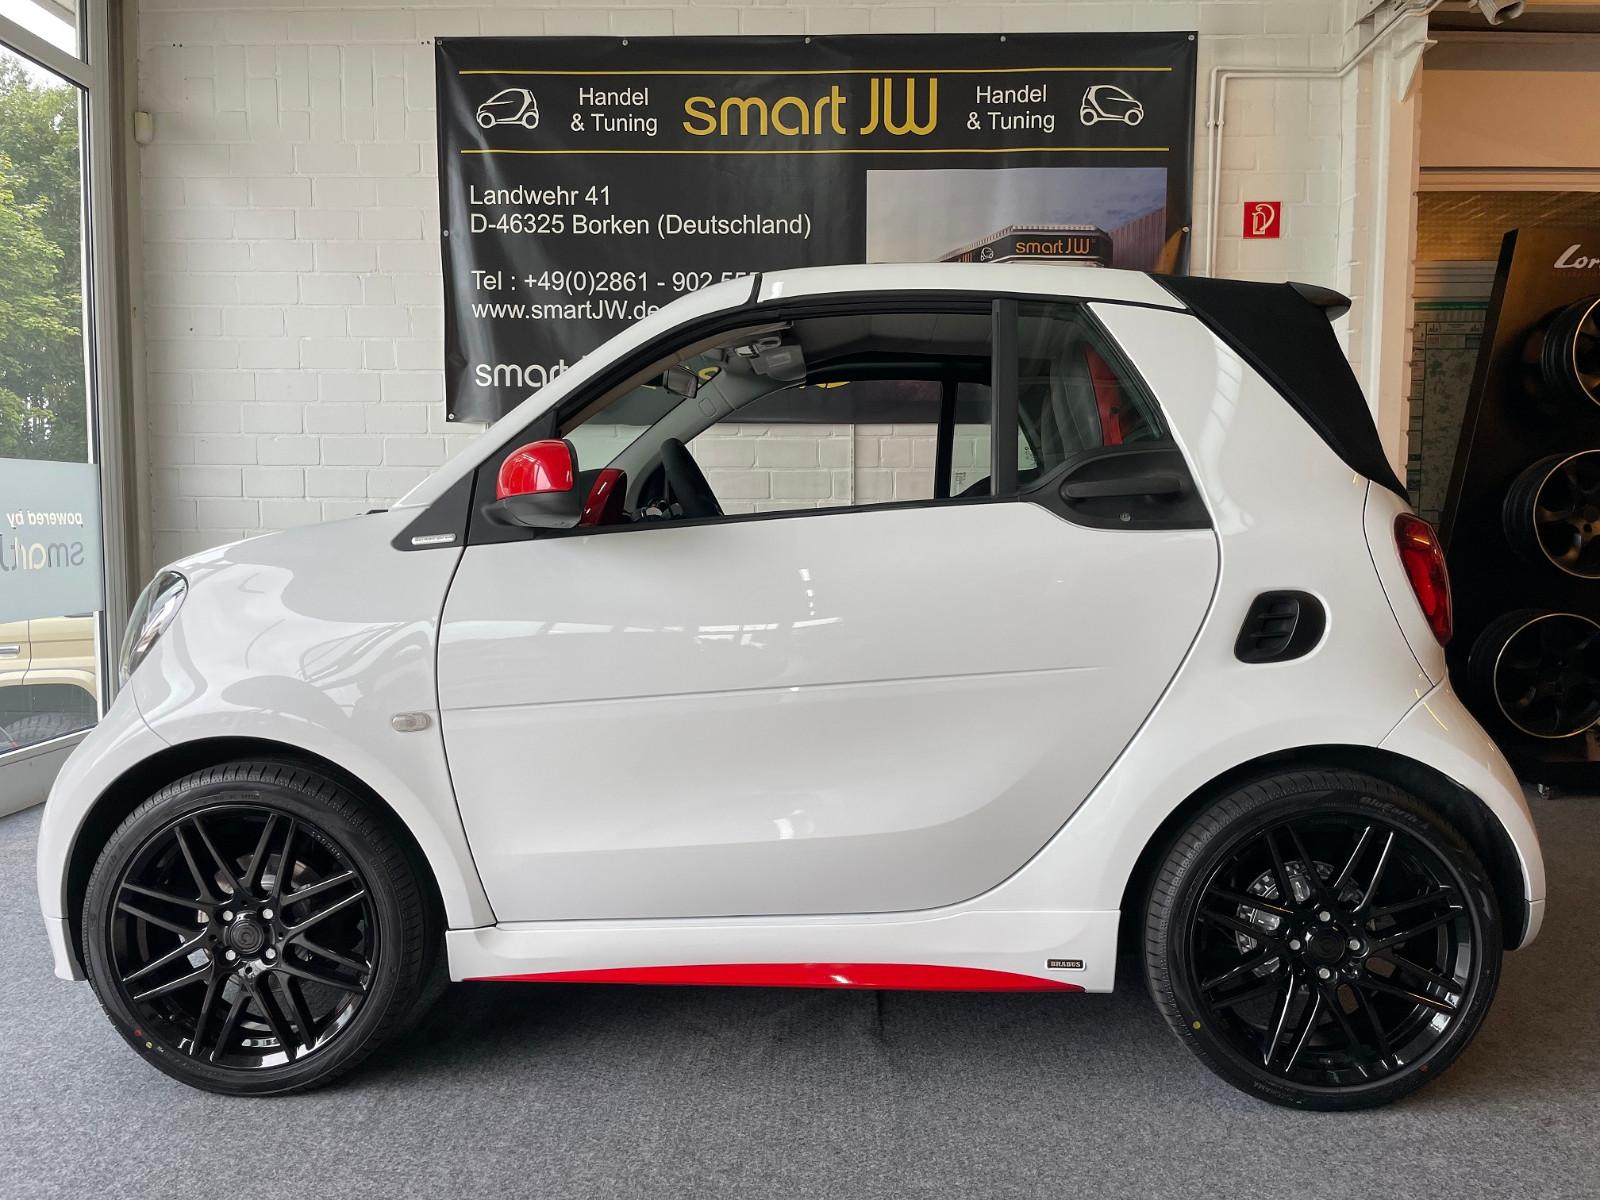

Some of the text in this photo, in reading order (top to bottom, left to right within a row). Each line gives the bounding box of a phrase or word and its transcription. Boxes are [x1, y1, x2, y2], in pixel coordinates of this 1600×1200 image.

[578, 87, 650, 107] Handel
[975, 84, 1048, 105] Handel
[682, 77, 939, 137] smart JW
[570, 113, 659, 137] & Tuning
[966, 110, 1056, 134] & Tuning
[470, 185, 611, 206] Landwehr 41
[470, 213, 812, 240] D-46325 Borken (Deutschland)
[1014, 238, 1090, 254] smart JW
[471, 270, 503, 291] Tel
[524, 271, 648, 296] +49(0)2861
[672, 271, 713, 292] 902
[471, 300, 660, 320] www.smartJW.de
[1049, 960, 1081, 968] BRABUS
